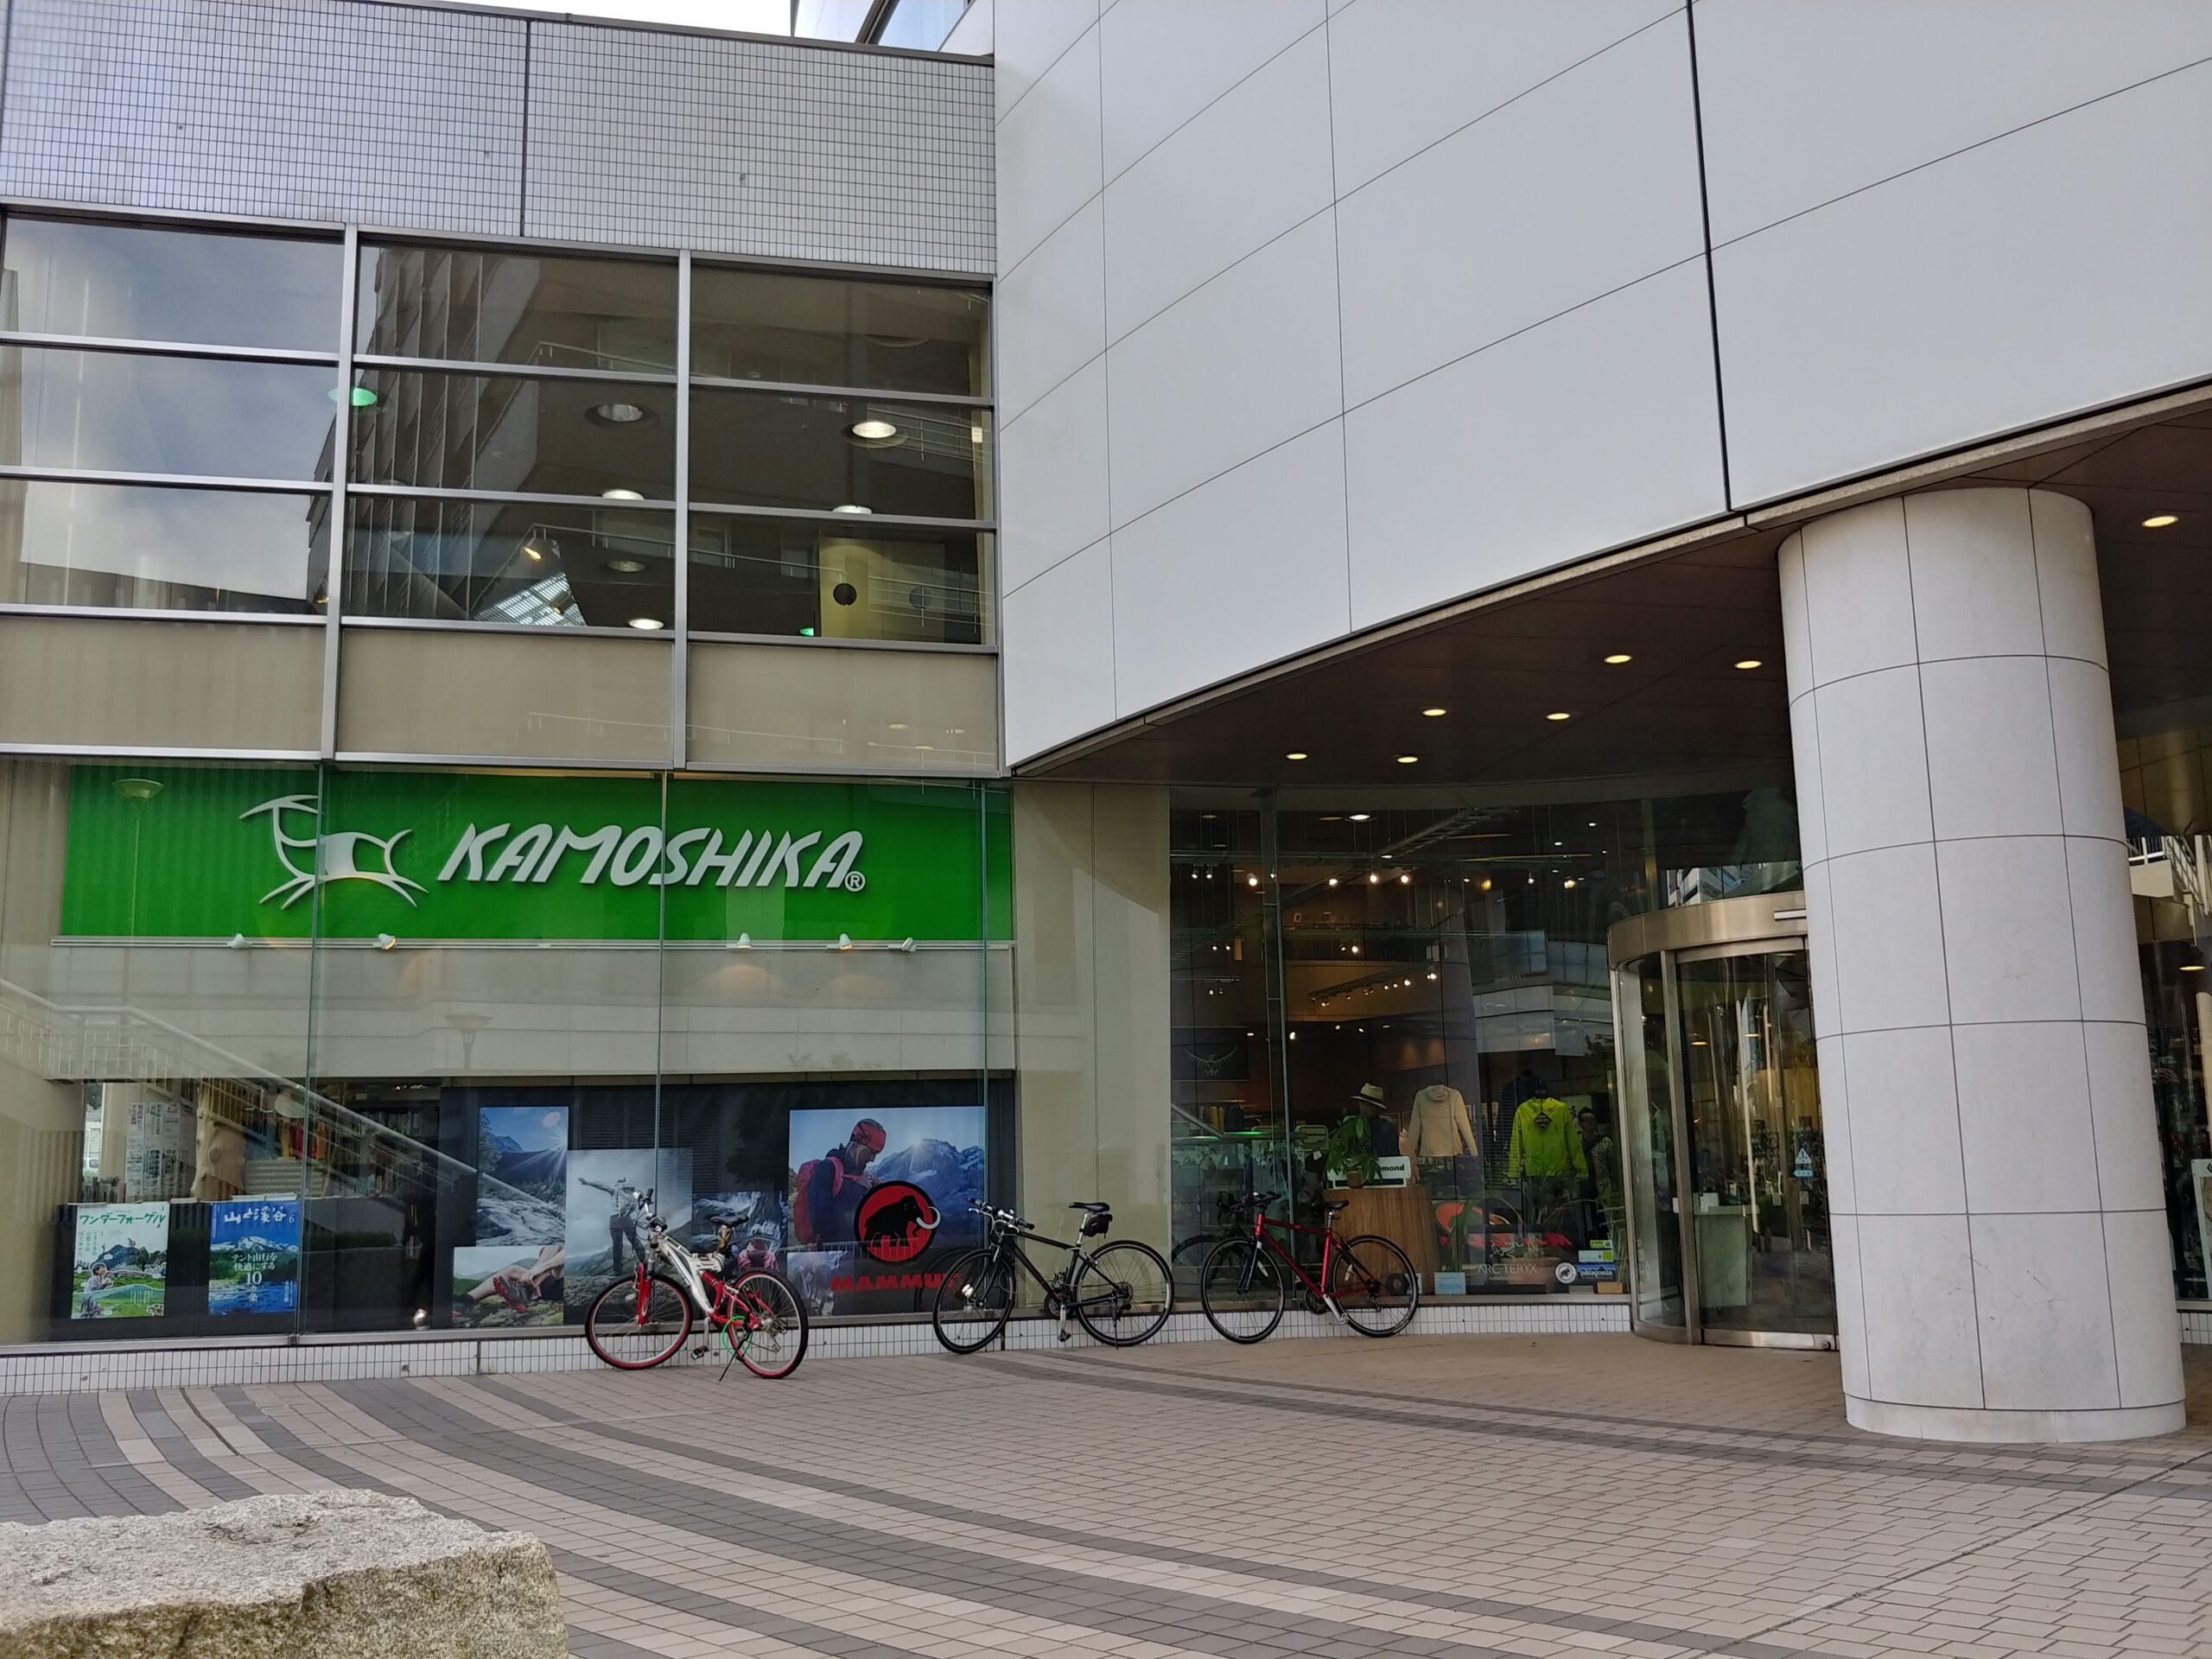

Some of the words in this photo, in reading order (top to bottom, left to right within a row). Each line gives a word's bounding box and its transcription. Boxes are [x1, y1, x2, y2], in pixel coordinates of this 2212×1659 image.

[79, 1211, 166, 1224] ワンダーフォーゲル
[245, 1271, 263, 1285] 10
